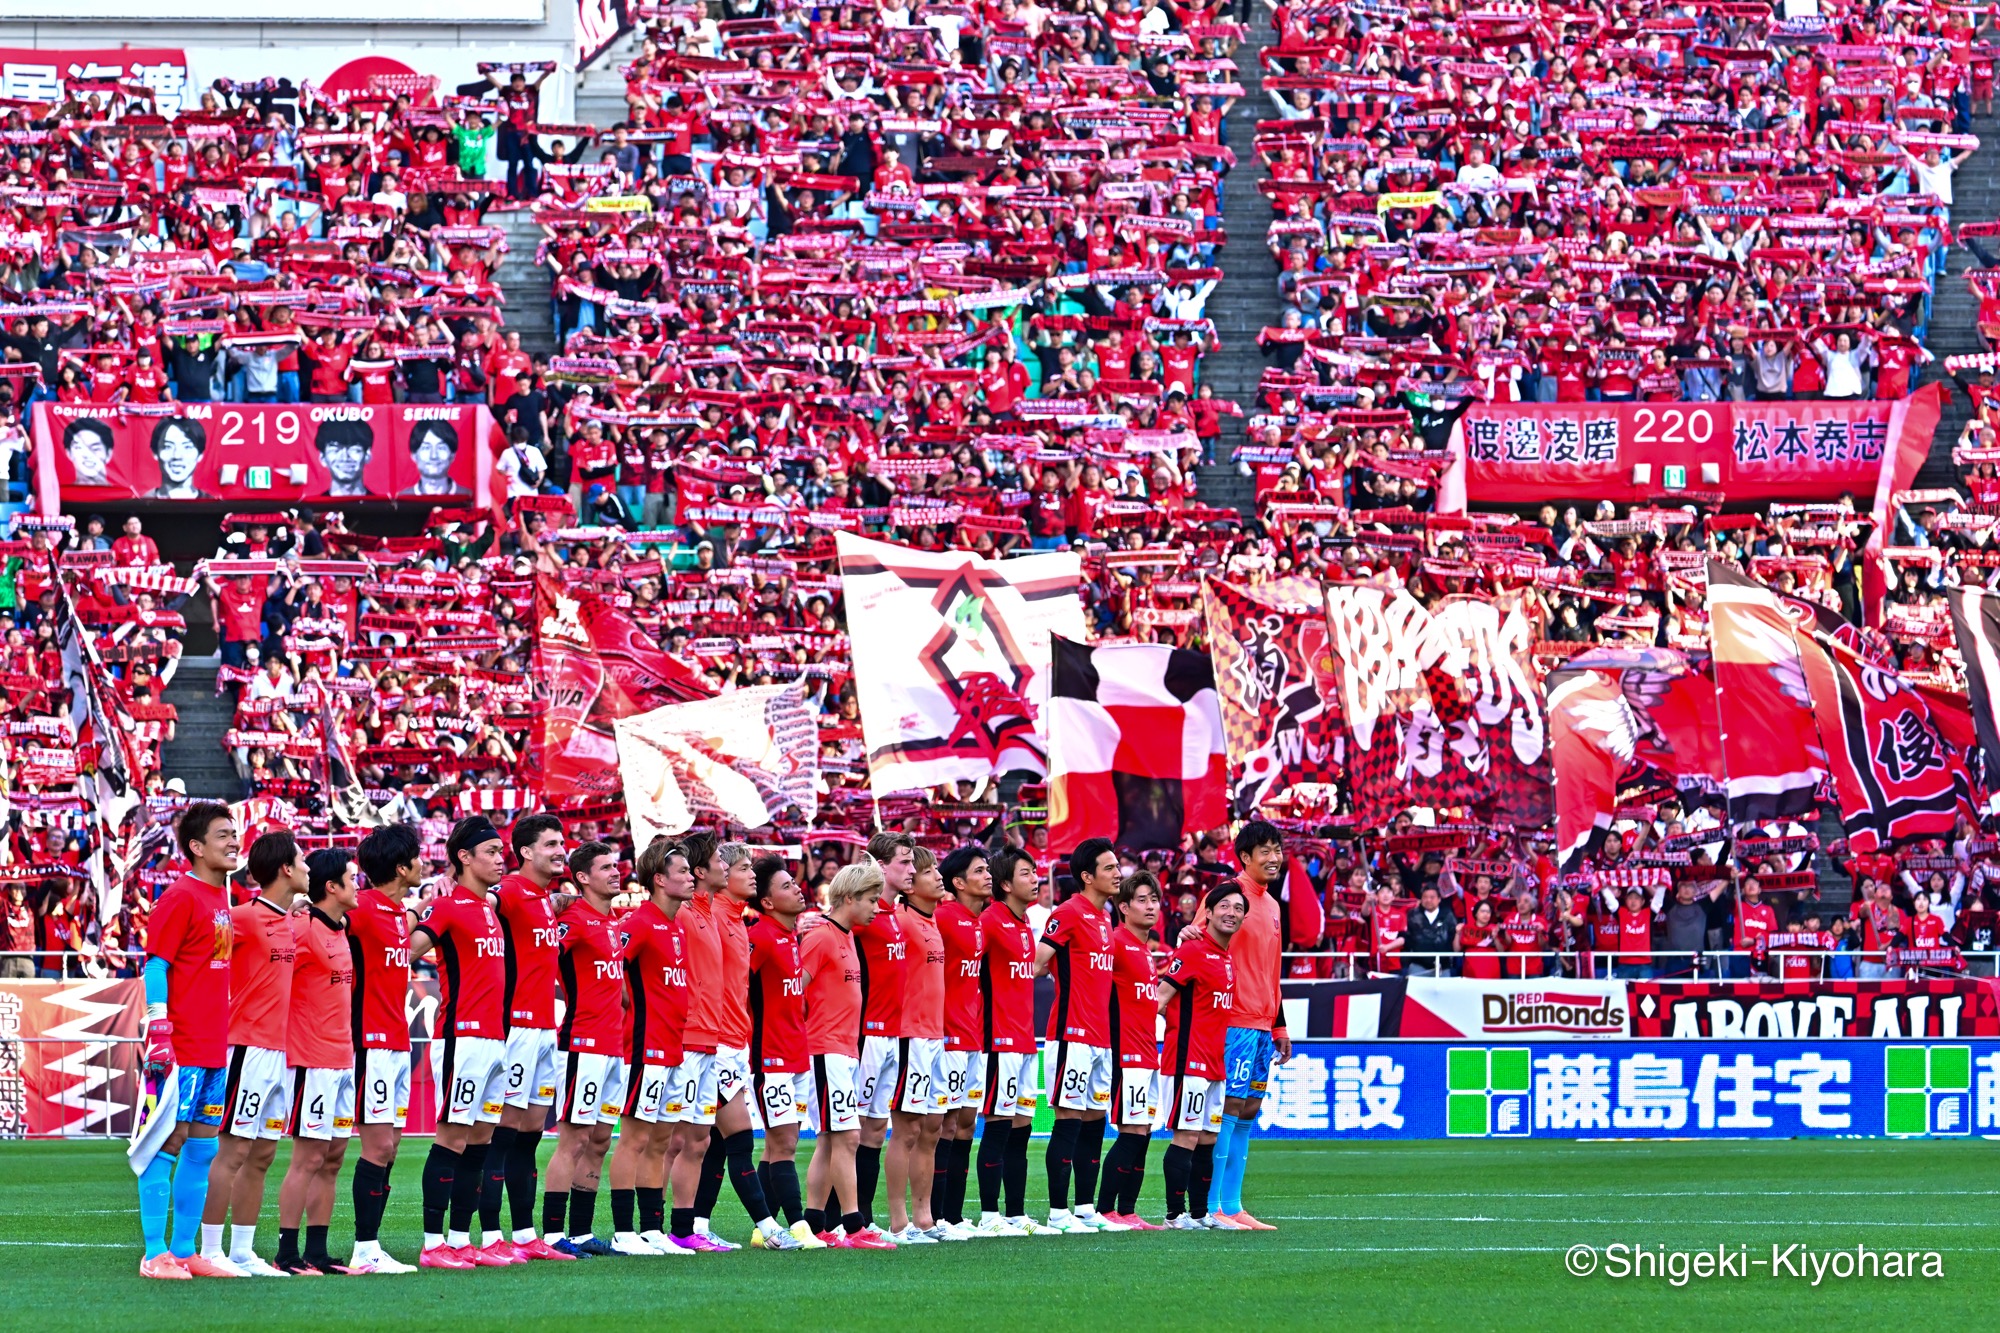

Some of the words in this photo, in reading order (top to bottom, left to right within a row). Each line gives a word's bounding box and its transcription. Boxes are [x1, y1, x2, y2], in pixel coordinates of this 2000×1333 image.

[309, 405, 375, 422] OKUBO
[402, 406, 461, 421] SEKINE
[1633, 408, 1713, 443] 220
[221, 411, 300, 446] 219
[1734, 418, 1888, 464] 松本泰志
[1876, 709, 1945, 782] 優
[1768, 931, 1796, 948] URAWA
[1797, 931, 1819, 947] REDS
[1482, 993, 1624, 1027] Diamonds
[1516, 993, 1543, 1006] RED
[508, 1063, 525, 1088] 3
[1064, 1068, 1087, 1093] 35
[1233, 1058, 1252, 1082] 16
[190, 1073, 198, 1100] 1
[373, 1079, 388, 1104] 9
[454, 1077, 476, 1105] 18
[583, 1081, 598, 1106] 8
[765, 1084, 792, 1109] 25
[863, 1076, 876, 1099] 5
[1006, 1076, 1017, 1099] 6
[1128, 1085, 1147, 1108] 14
[1533, 1053, 1852, 1130] 藤島住宅
[238, 1089, 261, 1118] 13
[310, 1094, 325, 1120] 4
[831, 1089, 857, 1113] 24
[1187, 1091, 1204, 1115] 10
